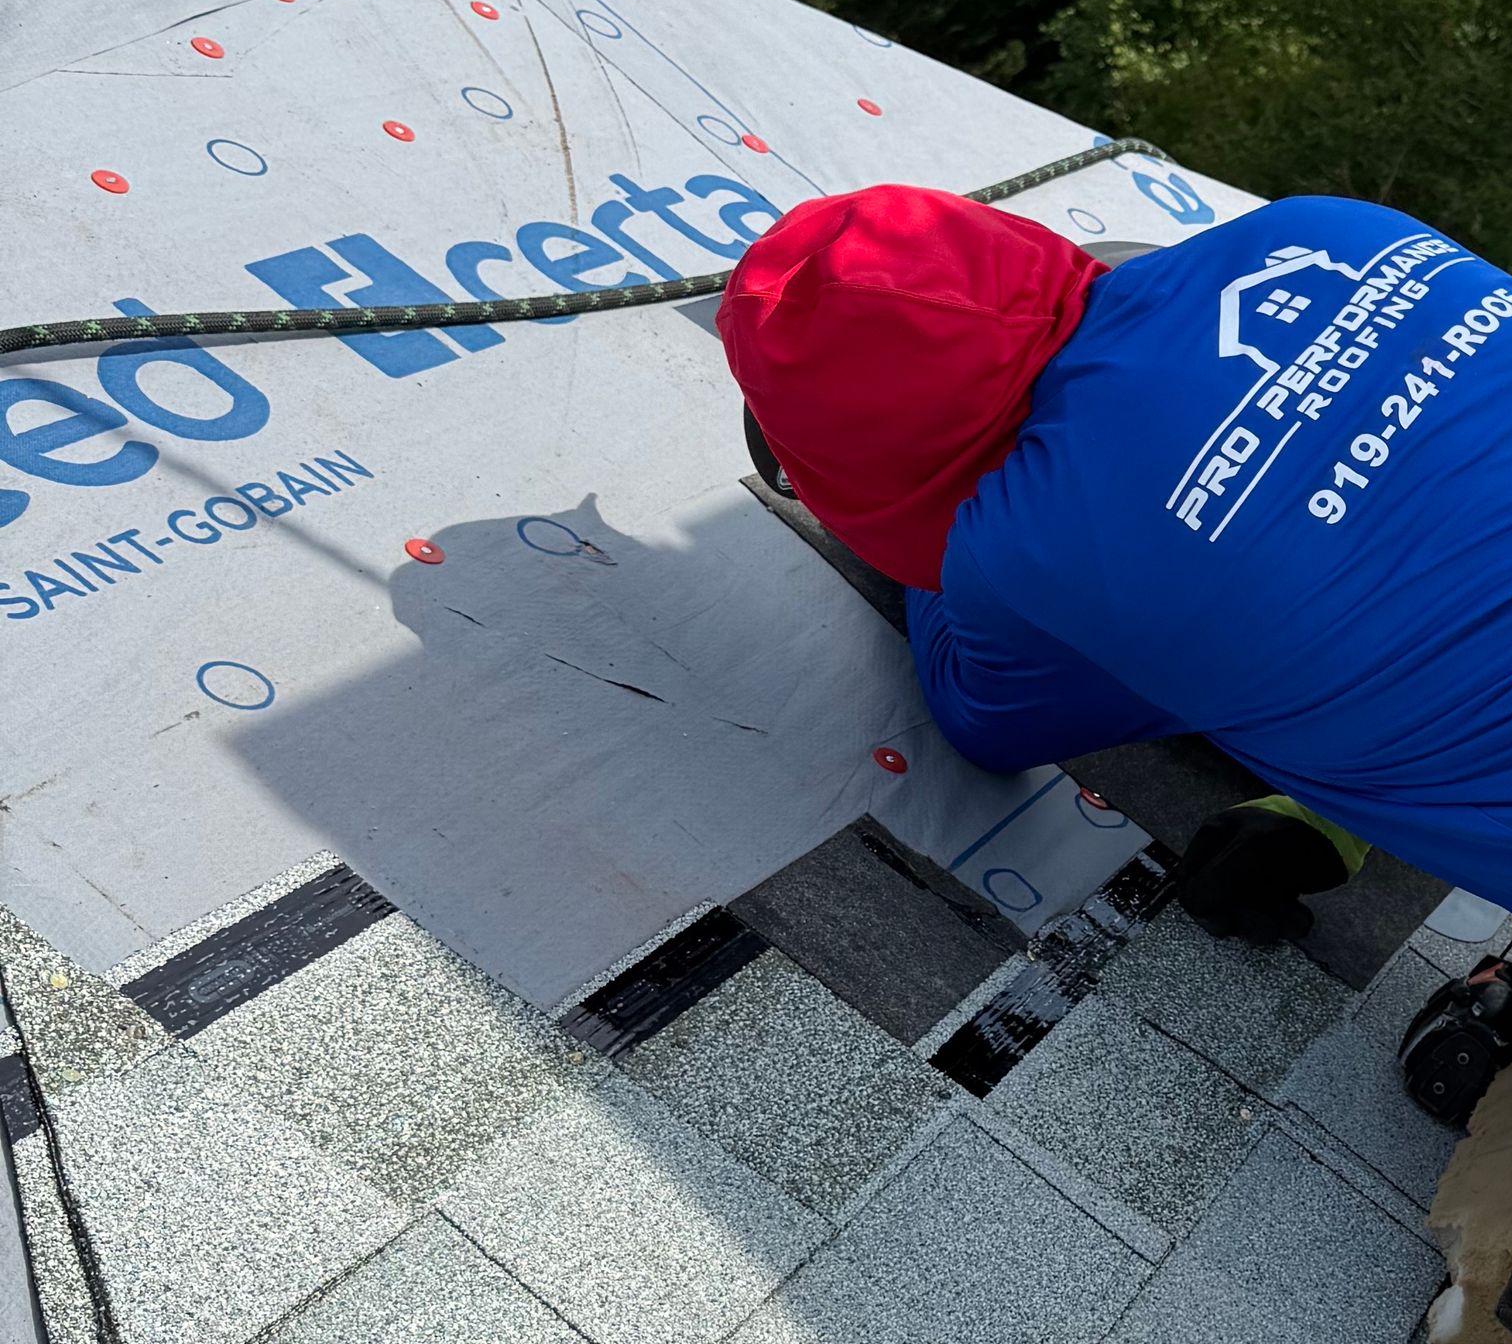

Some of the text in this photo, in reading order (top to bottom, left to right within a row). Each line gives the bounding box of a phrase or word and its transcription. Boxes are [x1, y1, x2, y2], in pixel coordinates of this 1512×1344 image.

[1176, 238, 1460, 531] PRO PERFORMANCE
[1297, 277, 1430, 421] ROOFING
[0, 449, 375, 619] SAINT-GOBAIN
